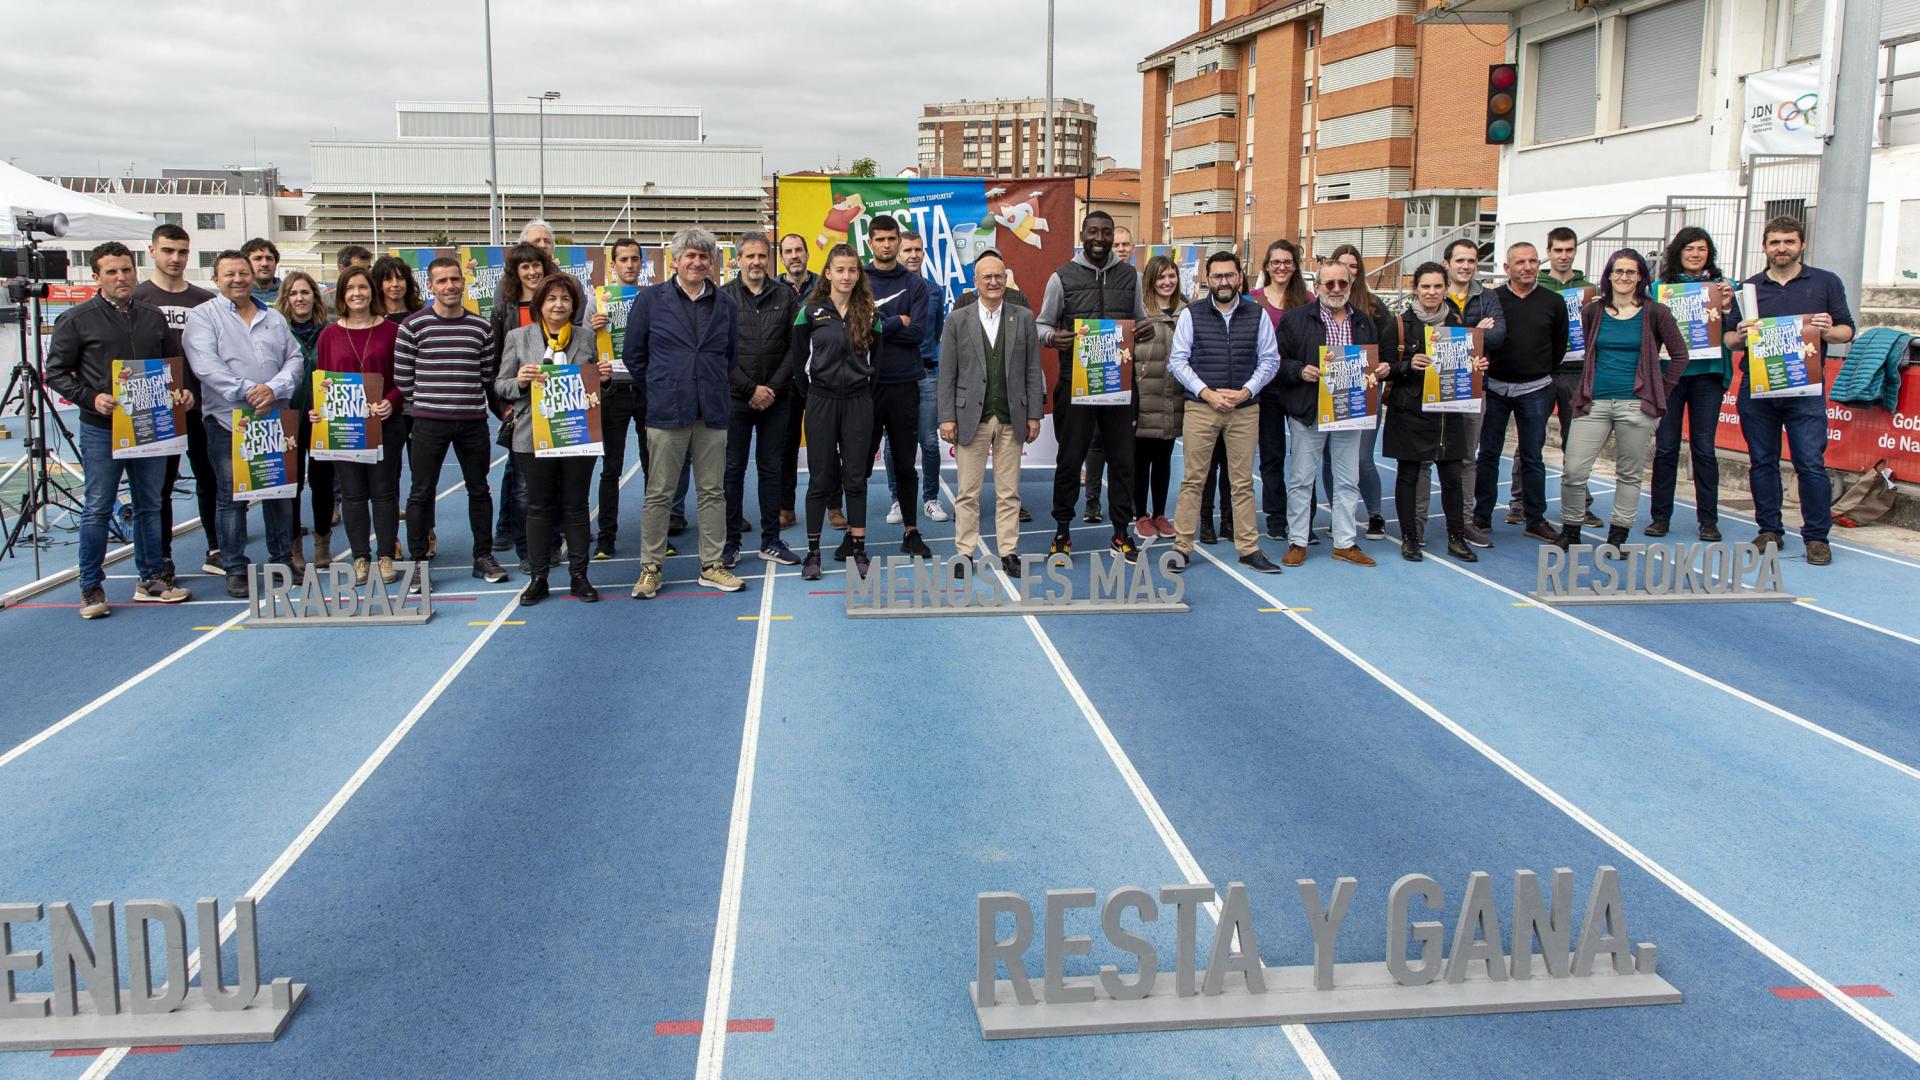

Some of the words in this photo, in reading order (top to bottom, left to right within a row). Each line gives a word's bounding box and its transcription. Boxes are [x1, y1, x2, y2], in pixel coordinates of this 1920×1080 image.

[1751, 104, 1773, 119] JDN
[326, 383, 367, 401] RESTA
[543, 373, 585, 397] RESTA
[243, 418, 284, 441] RESTA
[1878, 433, 1896, 449] de
[846, 552, 1001, 609] MENOS
[1020, 551, 1073, 606] ES
[1537, 541, 1785, 596] RESTOKOPA
[247, 560, 432, 618] IRABAZI
[976, 881, 1266, 1008] RESTA
[1296, 877, 1358, 992] Y
[1386, 865, 1657, 987] GANA.
